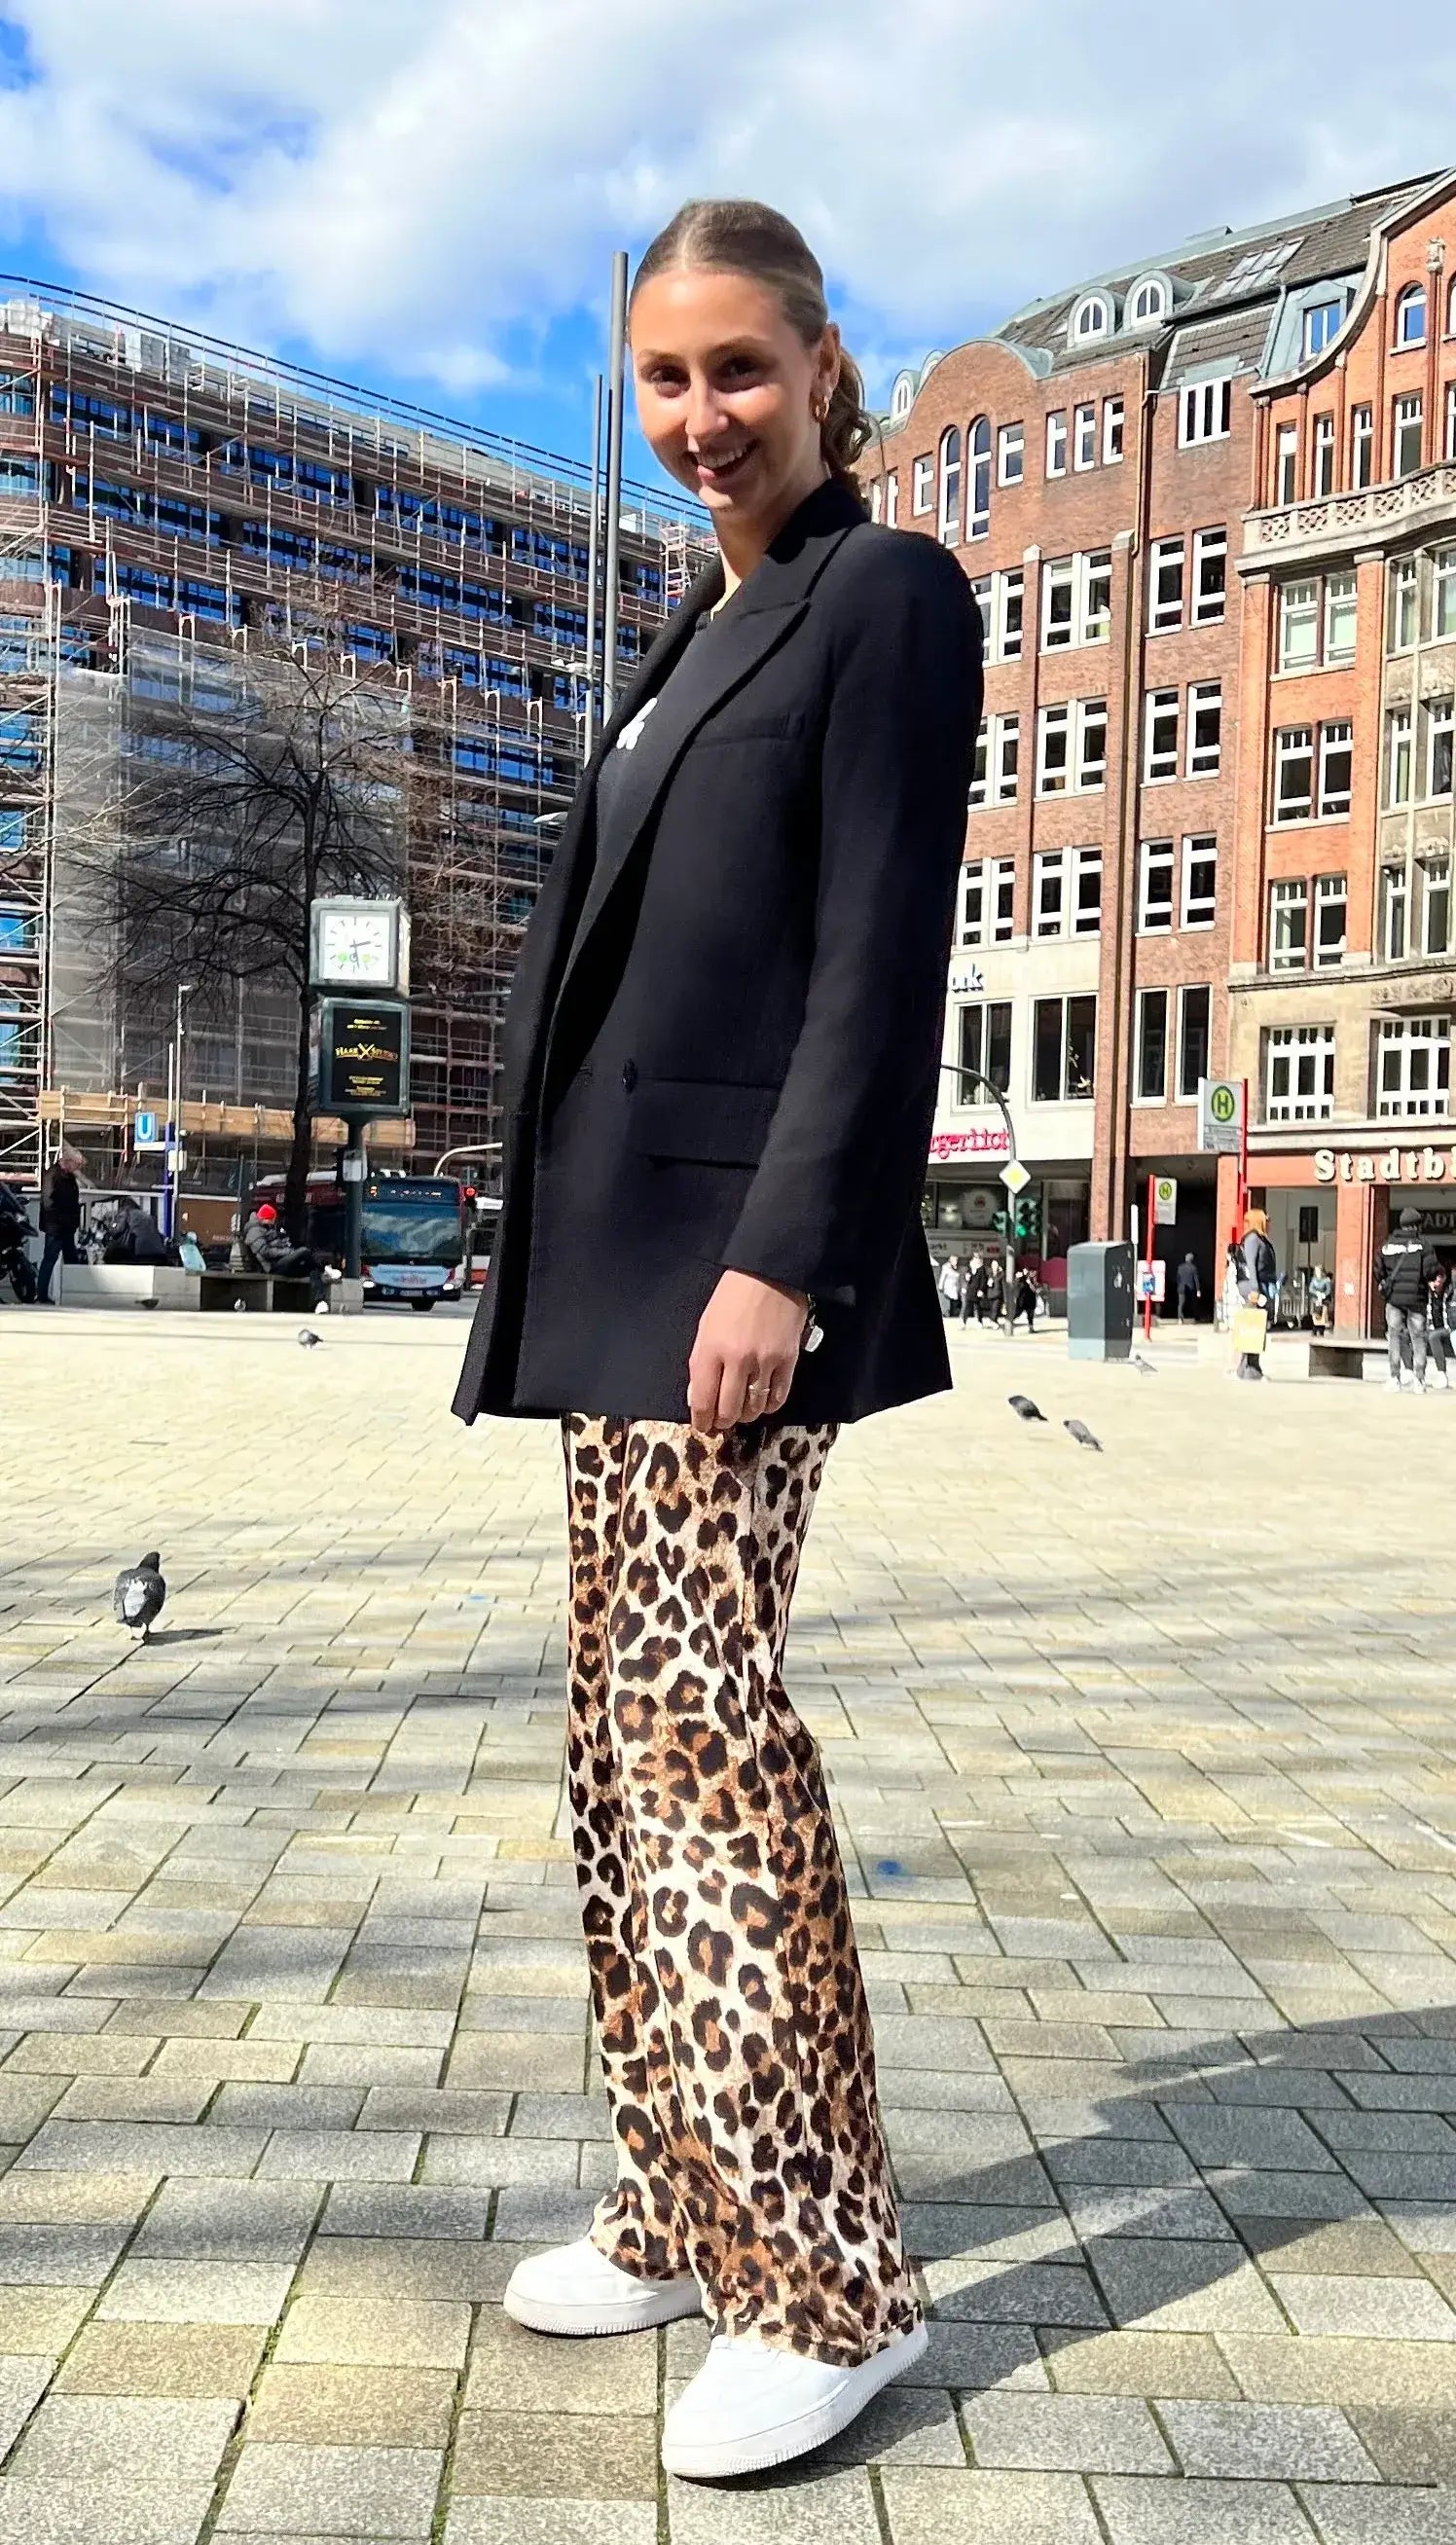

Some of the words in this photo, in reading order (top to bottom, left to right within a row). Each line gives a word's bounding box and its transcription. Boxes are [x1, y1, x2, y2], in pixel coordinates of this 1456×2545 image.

[1217, 1092, 1230, 1113] H
[137, 1113, 152, 1140] U
[1314, 1145, 1456, 1182] Stadtb
